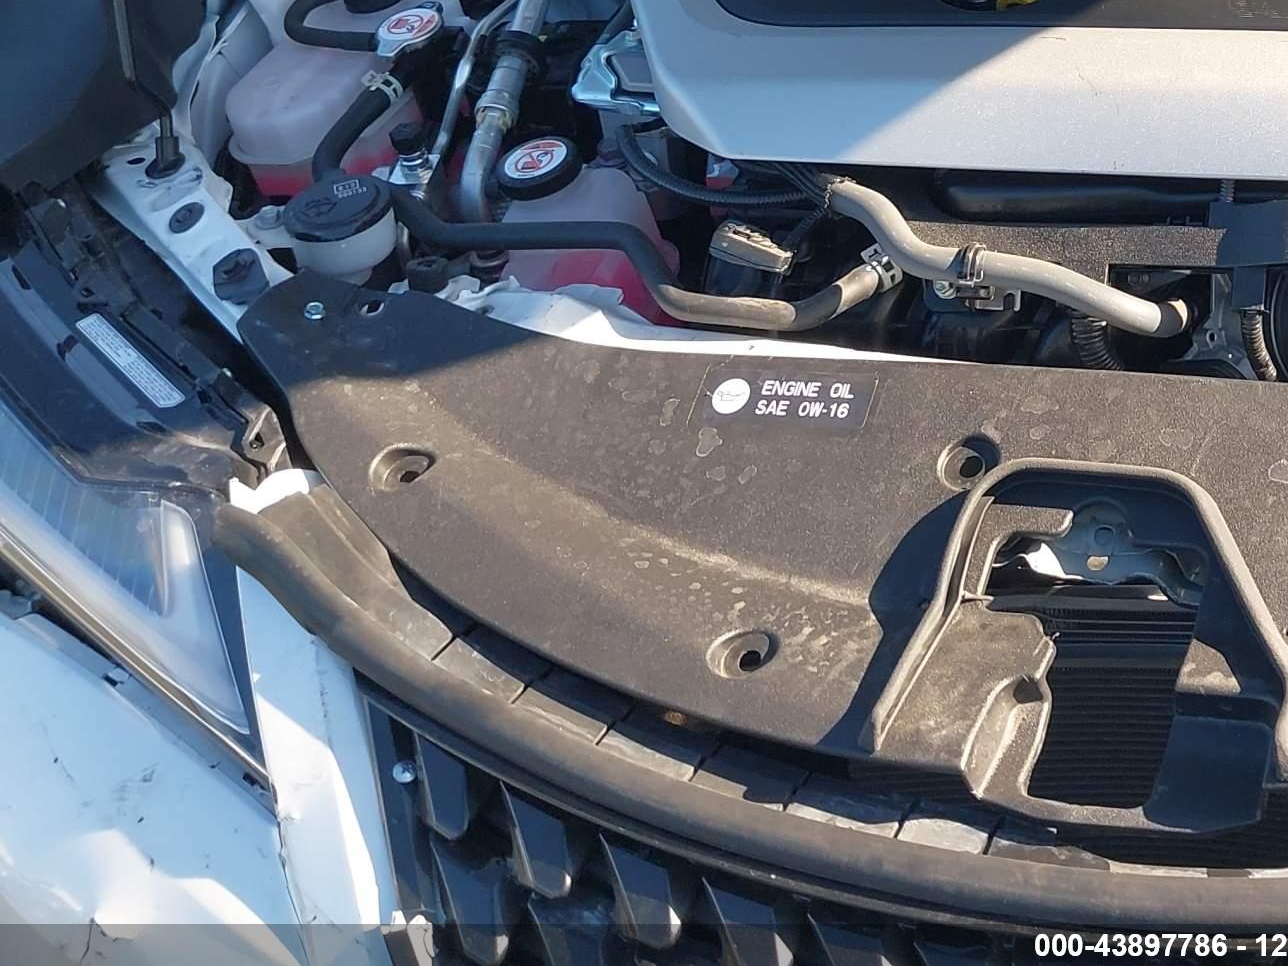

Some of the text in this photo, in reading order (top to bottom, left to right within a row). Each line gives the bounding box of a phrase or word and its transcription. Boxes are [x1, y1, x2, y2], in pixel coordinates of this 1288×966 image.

[761, 380, 854, 399] ENGINE OIL
[755, 400, 850, 418] SAE 0W-16
